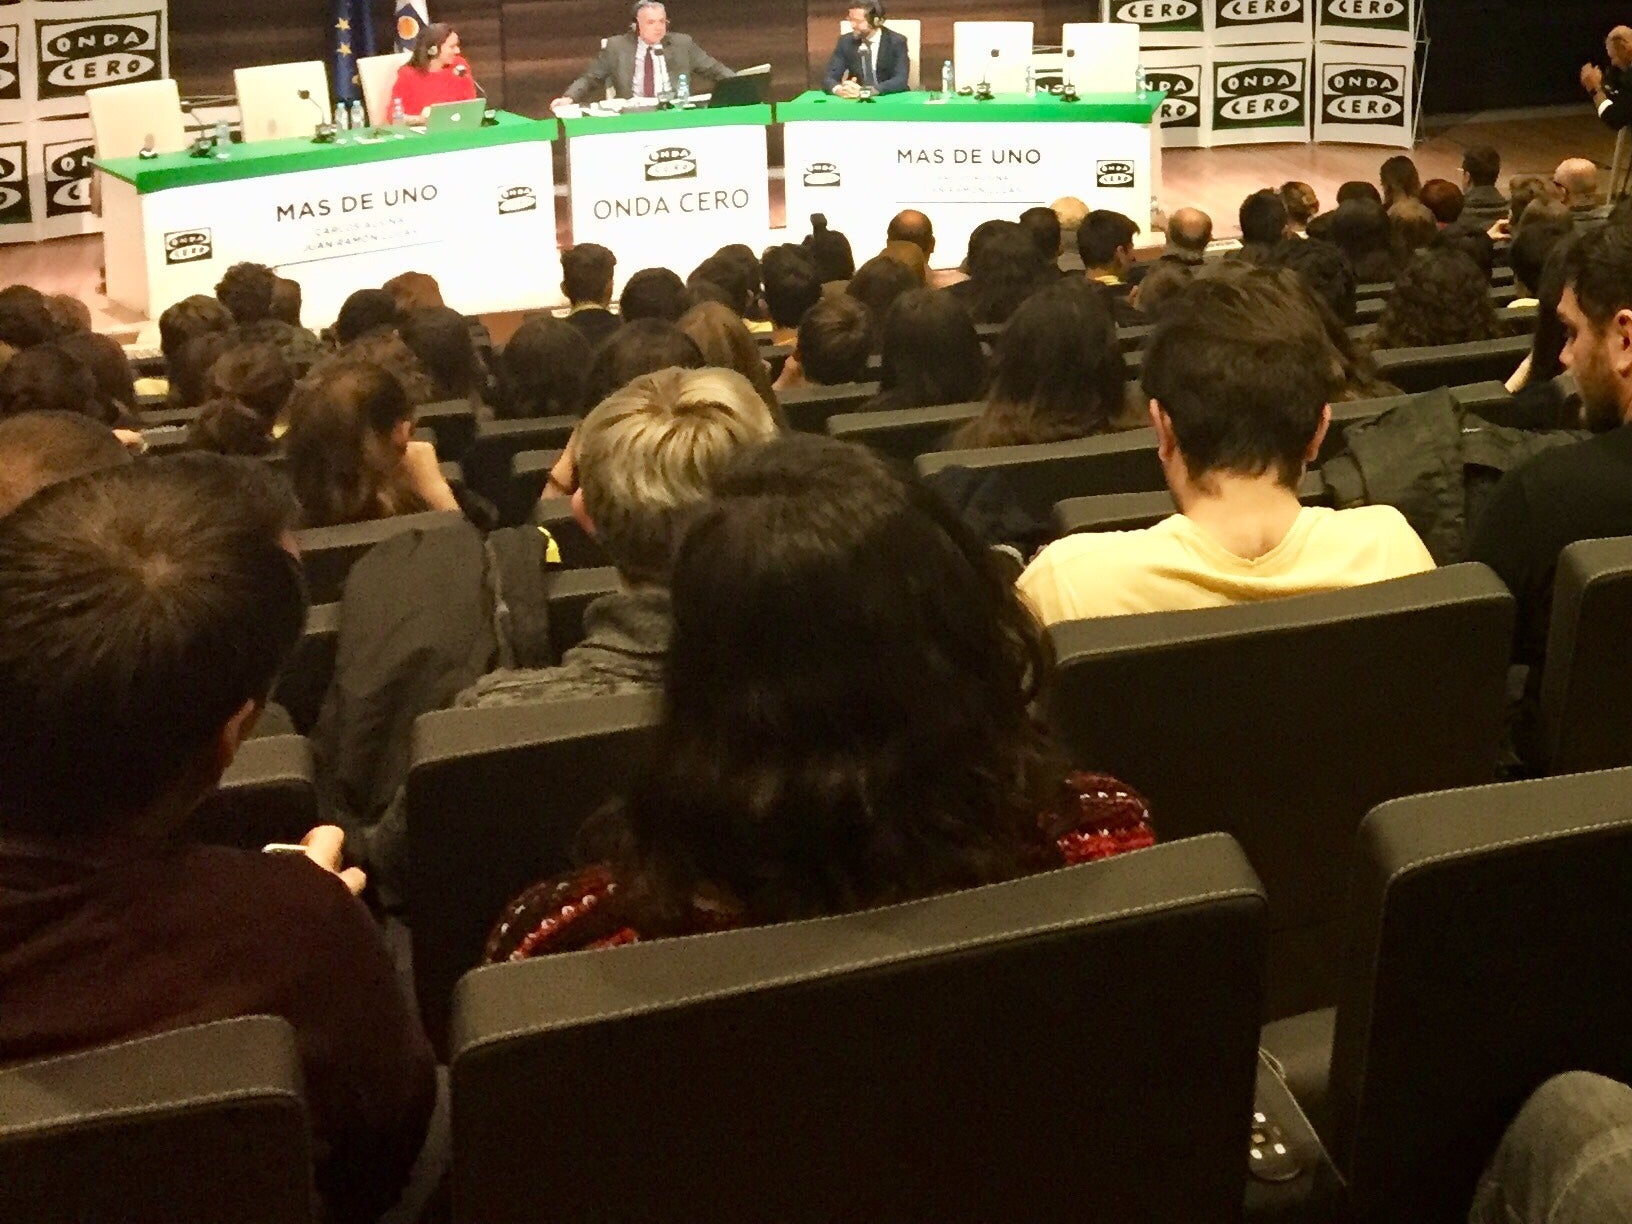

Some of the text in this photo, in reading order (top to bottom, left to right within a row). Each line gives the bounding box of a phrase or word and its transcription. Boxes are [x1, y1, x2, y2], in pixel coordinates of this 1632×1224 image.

[1128, 3, 1187, 19] CERO
[1338, 0, 1395, 15] CERO
[55, 30, 140, 53] ONDA
[63, 58, 141, 80] CERO
[1227, 74, 1289, 90] ONDA
[1333, 76, 1393, 90] ONDA
[1231, 98, 1290, 115] CERO
[1336, 101, 1393, 115] CERO
[897, 148, 1042, 165] MAS DE UNO
[276, 184, 439, 223] MAS DE UNO
[592, 188, 750, 221] ONDA CERO
